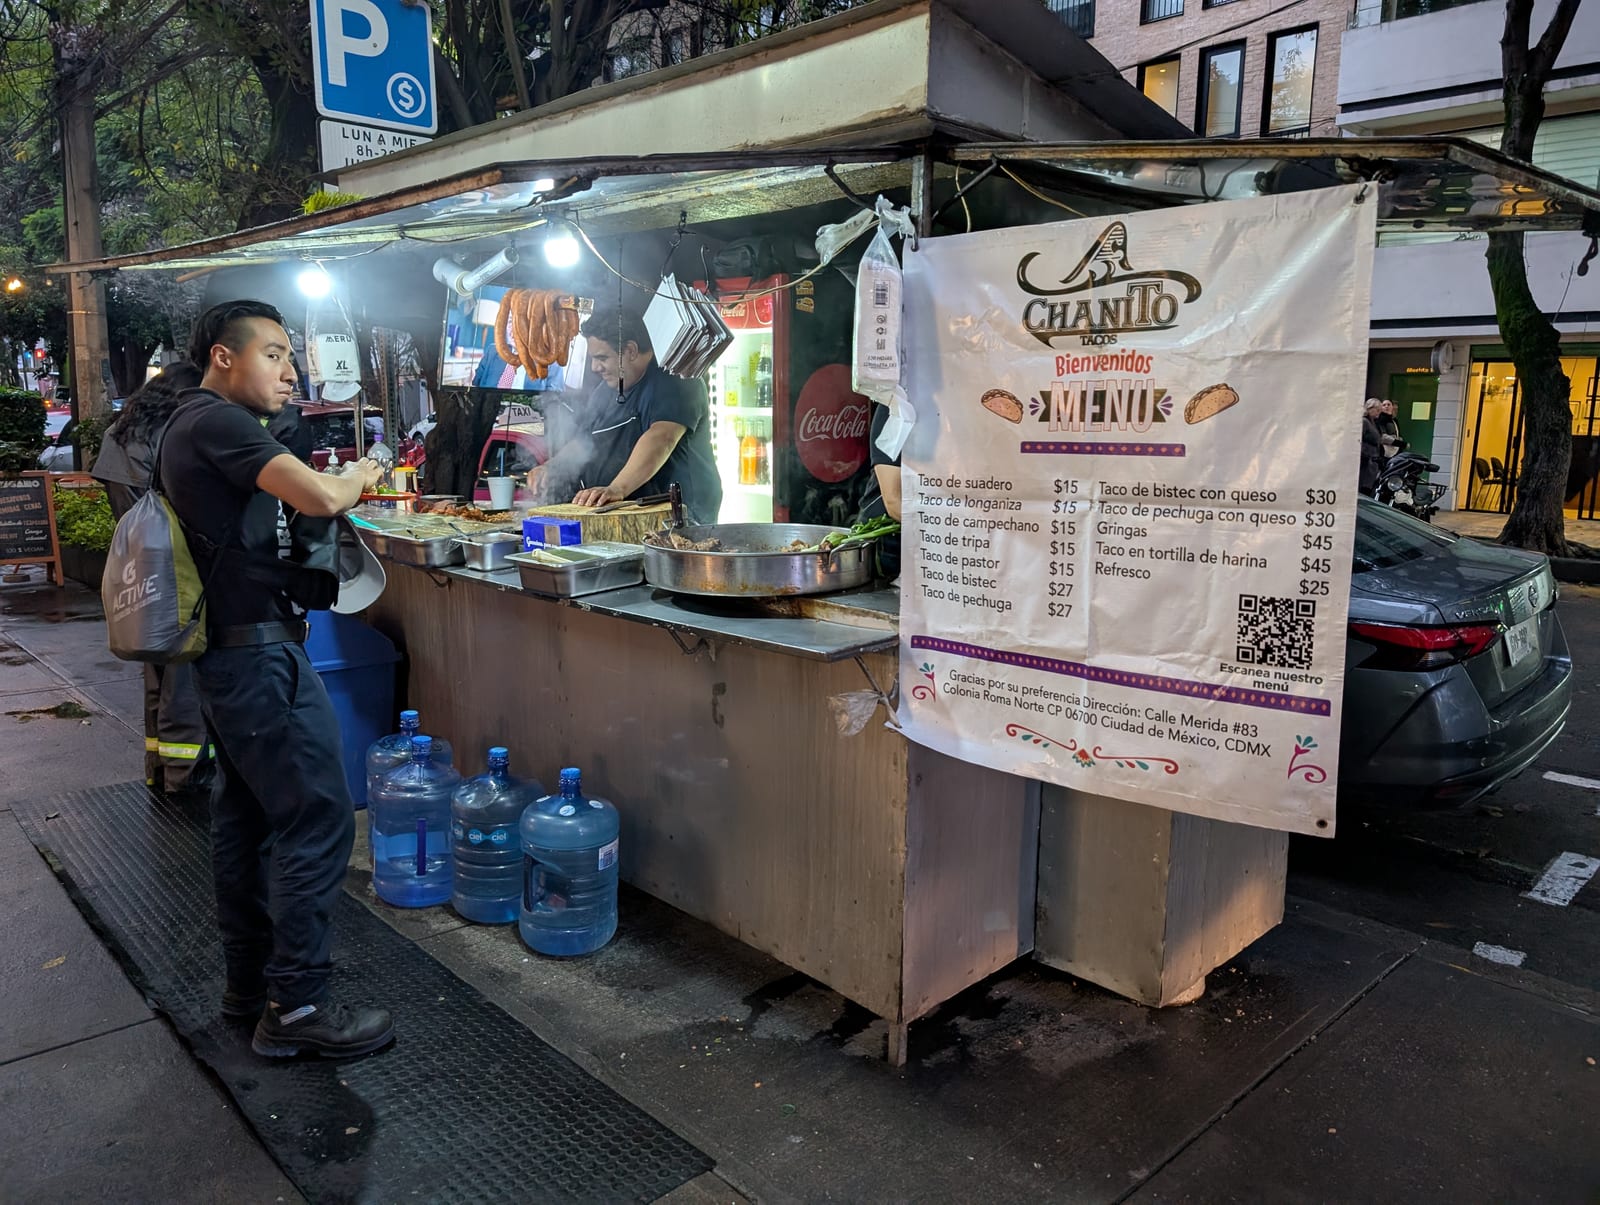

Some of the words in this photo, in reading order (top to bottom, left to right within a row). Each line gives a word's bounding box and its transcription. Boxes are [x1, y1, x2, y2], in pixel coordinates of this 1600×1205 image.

[323, 0, 389, 87] P
[341, 126, 372, 143] LUN
[377, 133, 387, 146] A
[1022, 281, 1178, 332] CHANITO
[1080, 335, 1117, 346] TACOS
[335, 360, 349, 370] XL
[1056, 348, 1153, 377] Bienvenidos
[512, 406, 532, 417] TAXI
[1048, 378, 1155, 433] MENU
[918, 474, 942, 487] Taco
[946, 475, 961, 488] de
[965, 476, 1012, 491] suadero
[1054, 479, 1078, 494] $15
[1099, 481, 1127, 496] Taco
[1132, 482, 1149, 497] de
[1153, 483, 1196, 499] bistec
[1200, 488, 1226, 500] con
[1231, 490, 1277, 504] queso
[1306, 488, 1337, 505] $30
[918, 493, 942, 506] Taco
[946, 495, 961, 507] de
[965, 495, 1022, 512] longaniza
[1053, 500, 1077, 514] $15
[1099, 501, 1127, 515] Taco
[1132, 502, 1149, 516] de
[1152, 504, 1213, 524] pechuga
[1218, 509, 1244, 522] con
[1250, 511, 1297, 527] queso
[1304, 510, 1335, 528] $30
[918, 511, 941, 525] Taco
[945, 513, 959, 526] de
[963, 517, 1039, 533] campechano
[1051, 520, 1076, 535] $15
[1097, 521, 1147, 540] Gringas
[1303, 534, 1333, 551] $45
[919, 530, 941, 544] Taco
[945, 532, 958, 546] de
[962, 535, 990, 551] tripa
[1050, 540, 1075, 556] $15
[920, 548, 942, 562] Taco
[945, 551, 958, 564] de
[962, 556, 1000, 570] pastor
[1049, 561, 1075, 576] $15
[1096, 541, 1125, 556] Taco
[1129, 546, 1145, 558] en
[1148, 547, 1195, 562] tortilla
[1200, 549, 1218, 564] de
[1222, 551, 1267, 568] harina
[1300, 556, 1331, 573] $45
[921, 566, 944, 581] Taco
[946, 570, 959, 583] de
[962, 572, 997, 589] bistec
[1048, 581, 1074, 597] $27
[1095, 562, 1151, 579] Refresco
[1299, 579, 1330, 595] $25
[113, 574, 159, 613] ACTIVE
[921, 584, 945, 599] Taco
[947, 589, 960, 602] de
[963, 594, 1012, 613] pechuga
[1048, 602, 1073, 618] $27
[1220, 663, 1270, 678] Escanea
[1274, 671, 1323, 685] nuestro
[1253, 680, 1289, 692] menú
[950, 669, 985, 686] Gracias
[988, 678, 1005, 690] por
[1008, 683, 1018, 693] su
[1022, 685, 1080, 706] preferencia
[1083, 696, 1141, 718] Dirección:
[1145, 707, 1176, 725] Calle
[1181, 714, 1228, 733] Merida
[1233, 722, 1258, 738] #83
[943, 683, 980, 700] Colonia
[984, 690, 1011, 706] Roma
[1014, 697, 1044, 713] Norte
[1047, 703, 1062, 717] CP
[1065, 707, 1097, 726] 06700
[1101, 715, 1144, 734] Ciudad
[1148, 725, 1164, 739] de
[1168, 728, 1220, 750] México,
[1225, 738, 1272, 758] CDMX
[469, 832, 482, 842] ciel
[491, 831, 507, 842] ciel
